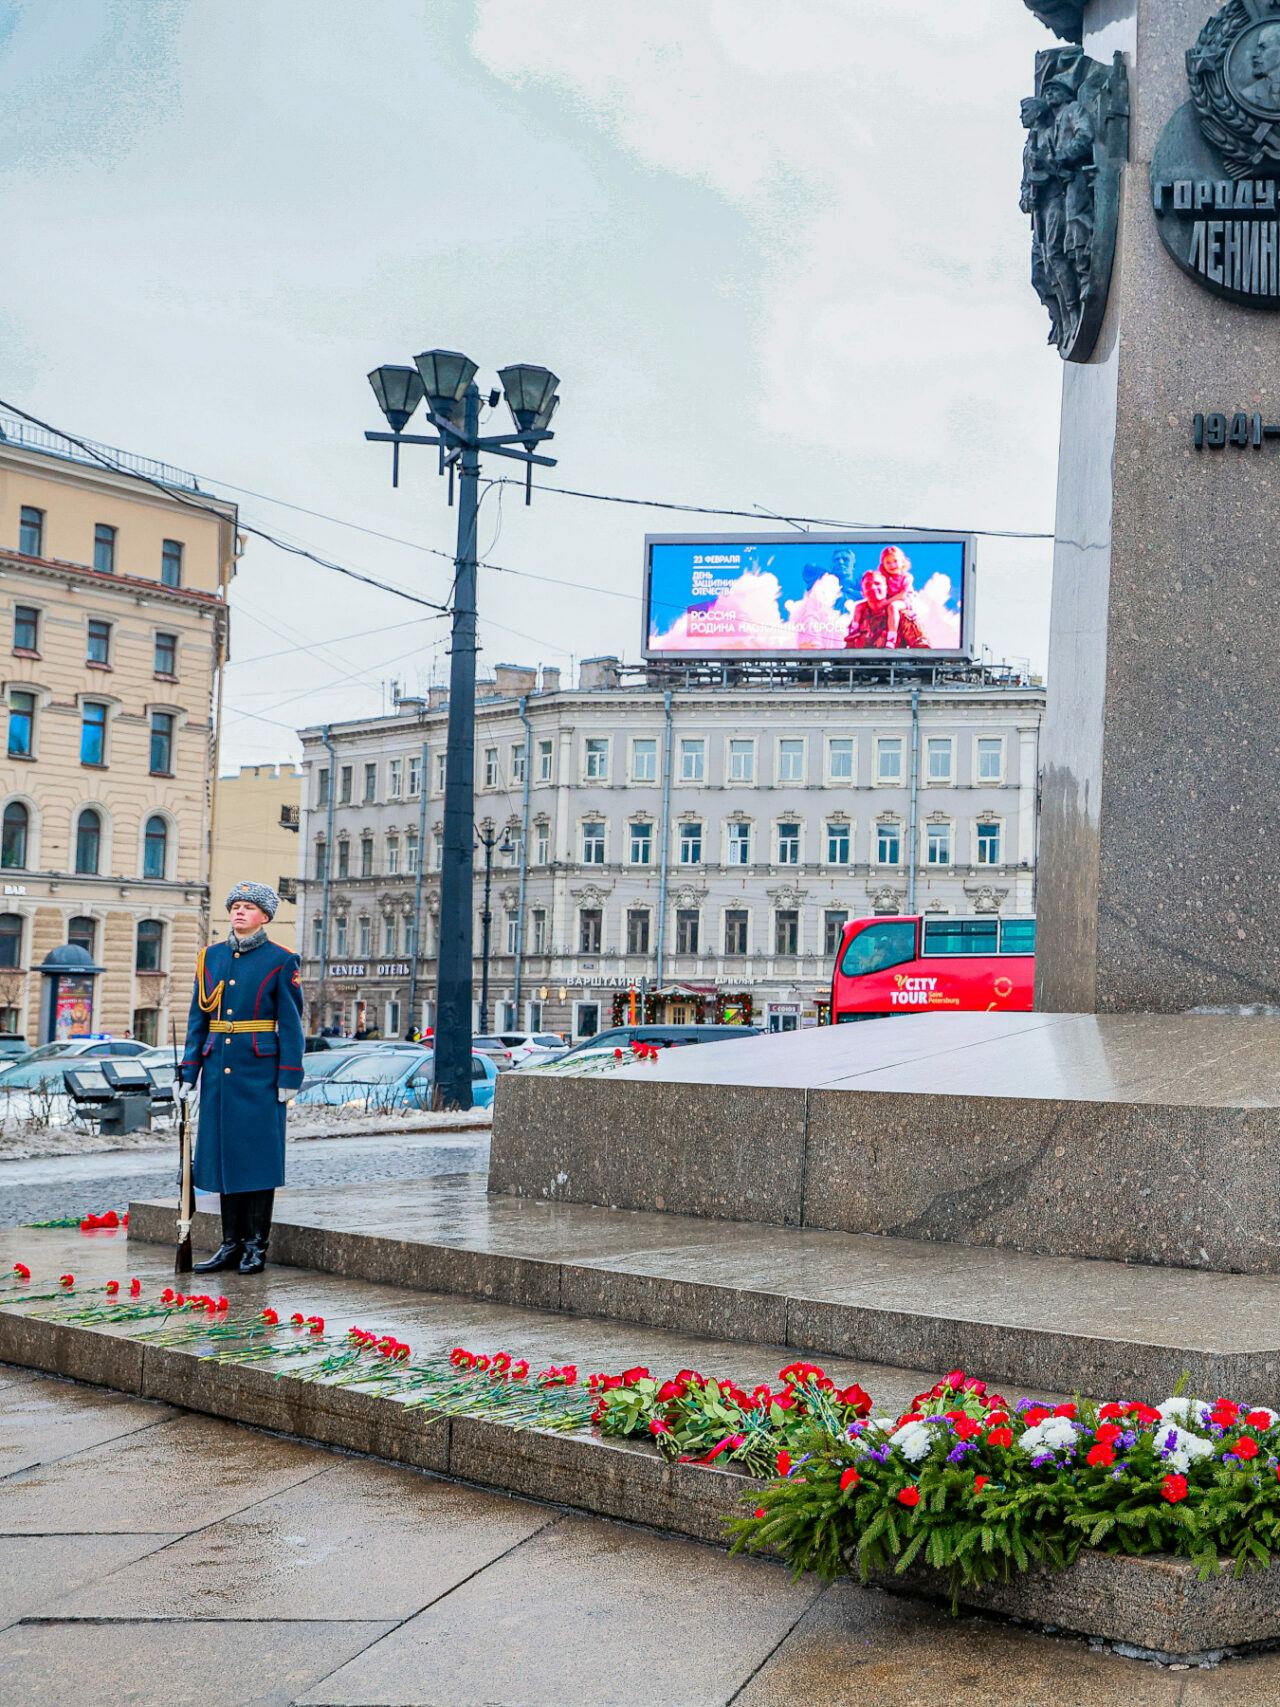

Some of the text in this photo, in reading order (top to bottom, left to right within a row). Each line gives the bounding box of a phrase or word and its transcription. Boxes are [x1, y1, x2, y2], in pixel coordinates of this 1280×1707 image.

[693, 555, 740, 564] 23 ФЕВРАЛЯ
[690, 611, 736, 621] РОССИЯ
[690, 622, 736, 634] РОДИНА
[4, 885, 26, 896] BAR
[329, 964, 365, 976] CENTER
[377, 964, 410, 975] ОТЕЛЬ
[905, 978, 938, 990] CITY
[890, 991, 928, 1004] TOUR
[928, 997, 960, 1005] Petersburg
